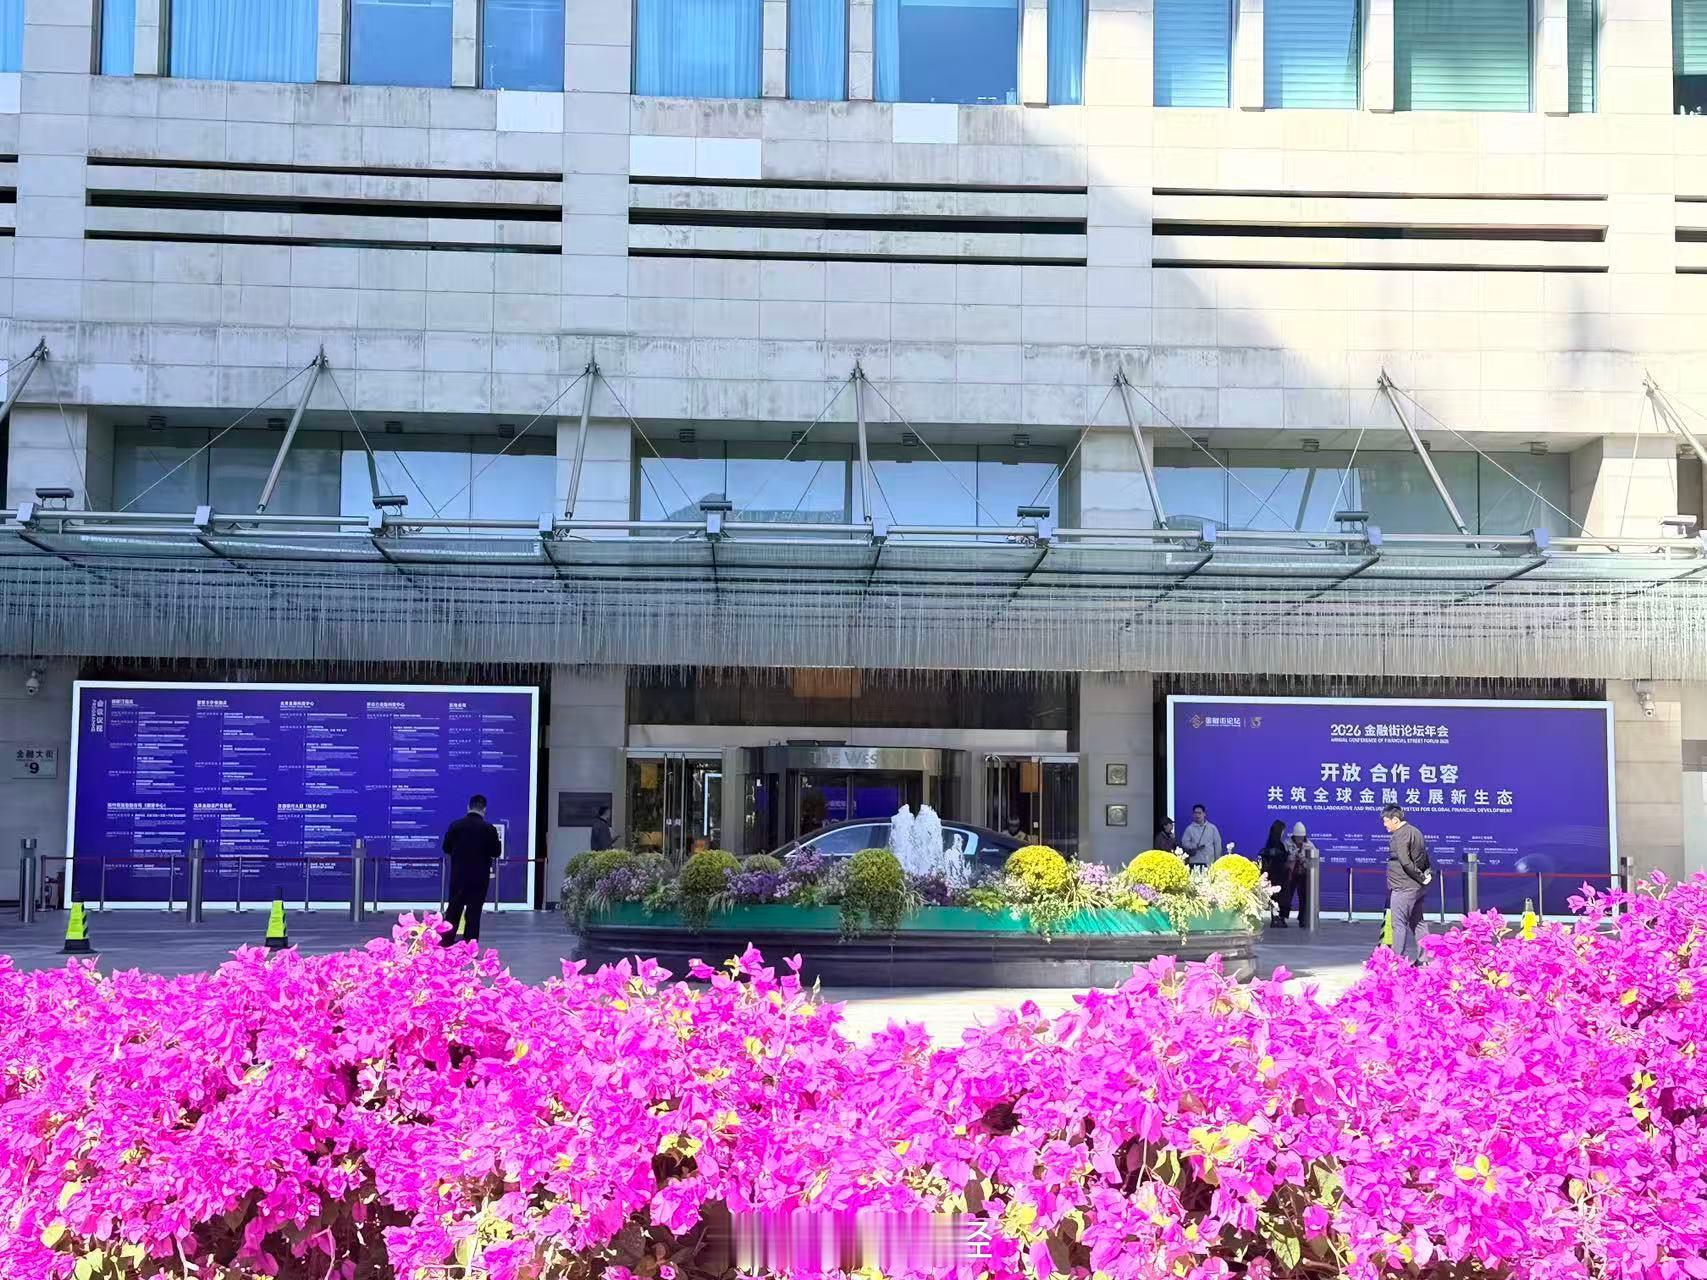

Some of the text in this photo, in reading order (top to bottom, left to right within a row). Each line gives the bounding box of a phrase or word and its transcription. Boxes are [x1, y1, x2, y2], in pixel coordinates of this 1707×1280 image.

[1330, 724, 1449, 737] 2026 金融街论坛年会
[29, 762, 40, 774] 9
[1320, 763, 1459, 784] 开放 合作 包容
[1267, 786, 1513, 805] 共筑全球金融发展新生态
